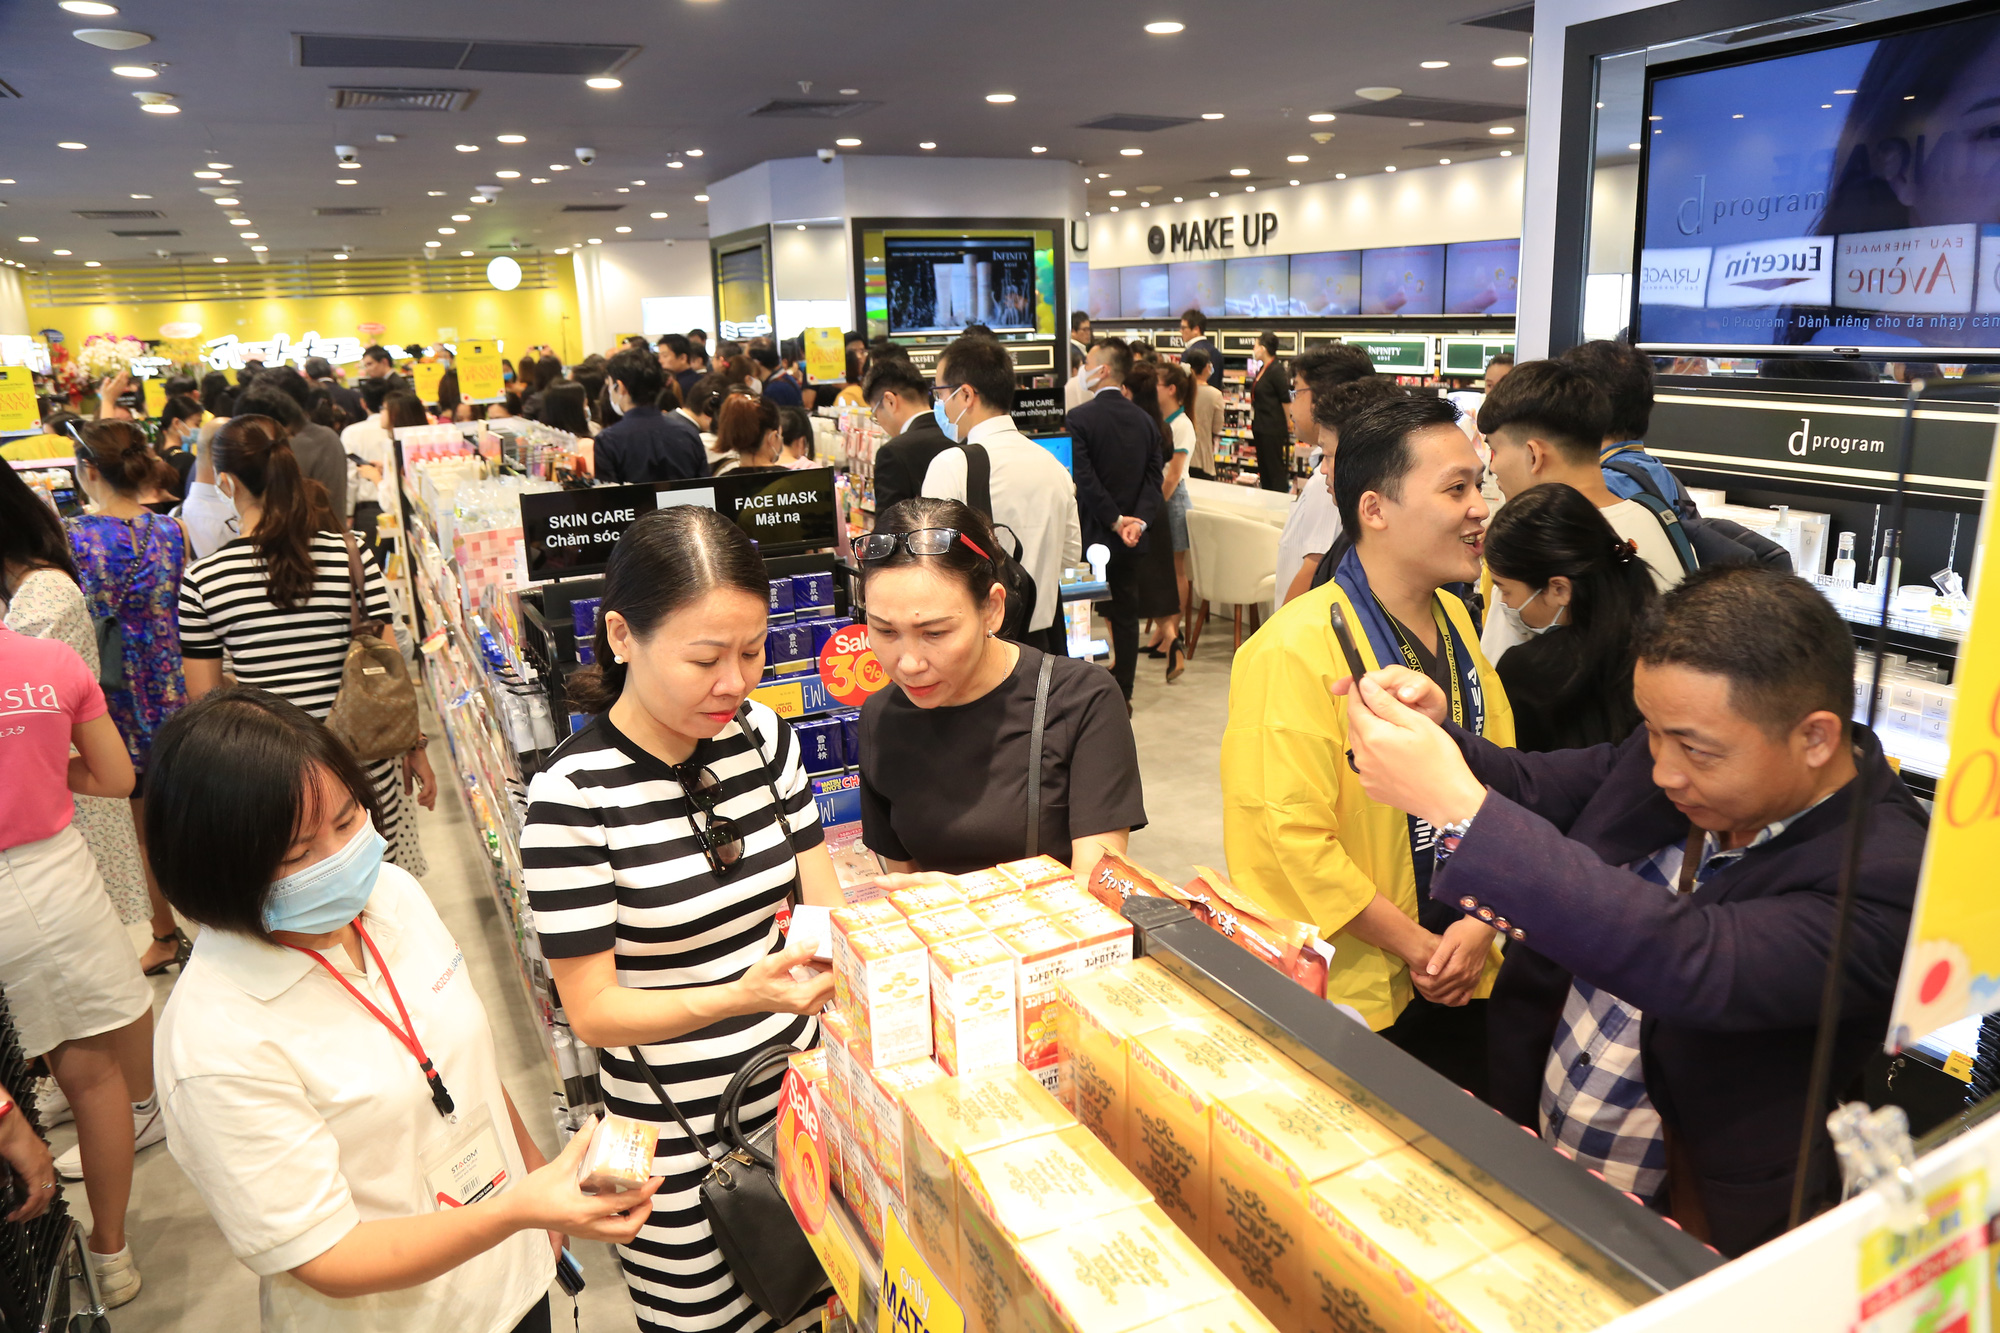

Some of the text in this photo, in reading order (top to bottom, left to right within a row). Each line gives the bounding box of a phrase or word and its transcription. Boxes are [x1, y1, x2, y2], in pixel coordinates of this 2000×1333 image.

[1677, 174, 1827, 236] d program
[1170, 212, 1278, 252] MAKE UP
[992, 250, 1029, 261] INFINITY
[1733, 315, 1785, 330] Program
[1798, 315, 1831, 328] Dành
[1835, 314, 1870, 331] riêng
[1875, 315, 1901, 328] cho
[1906, 315, 1923, 328] da
[1929, 315, 1966, 331] nhạy
[1368, 344, 1402, 356] INFINITY
[1020, 399, 1055, 408] SUN CARE
[1788, 418, 1885, 456] d program
[734, 491, 818, 510] FACE MASK
[549, 508, 635, 530] SKIN CARE
[755, 511, 801, 529] Mặt nạ
[545, 526, 620, 548] Chăm sóc
[0, 682, 60, 710] sta
[803, 681, 828, 710] EW!
[820, 798, 836, 824] W!
[789, 1070, 819, 1142] Sale
[451, 1148, 479, 1175] STACOM
[883, 1268, 930, 1333] MAT
[900, 1266, 930, 1321] only
